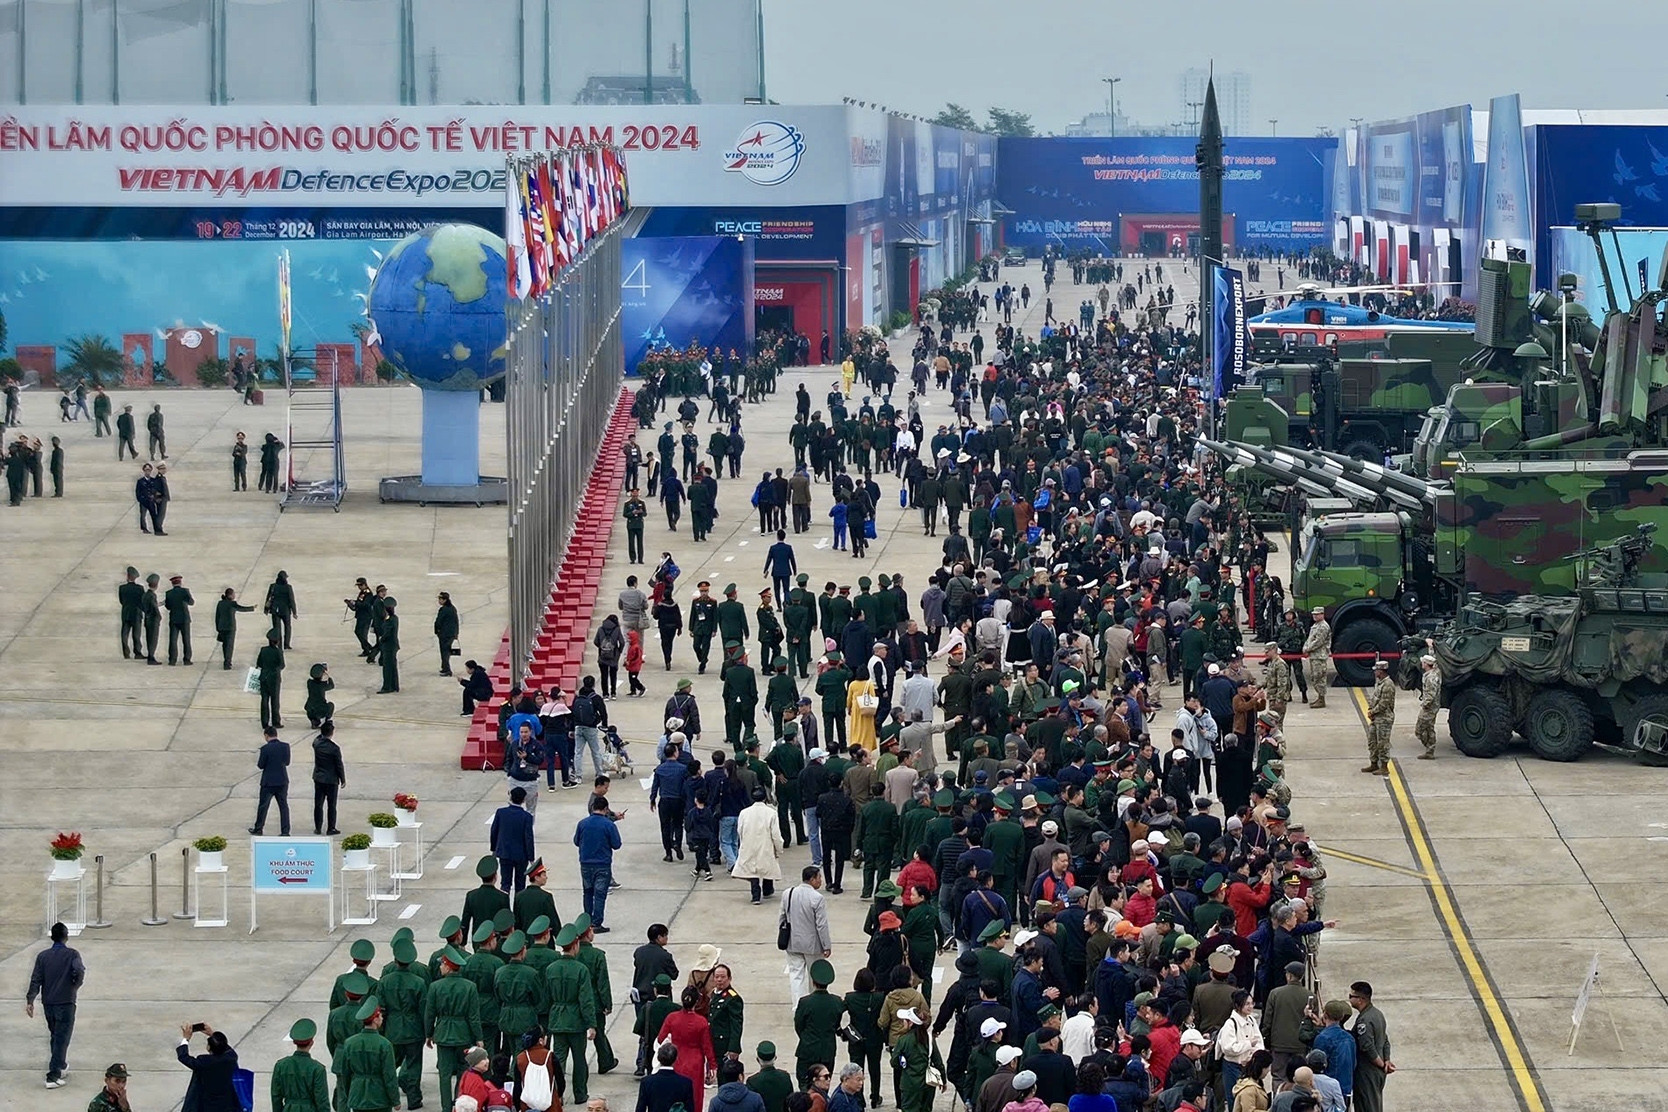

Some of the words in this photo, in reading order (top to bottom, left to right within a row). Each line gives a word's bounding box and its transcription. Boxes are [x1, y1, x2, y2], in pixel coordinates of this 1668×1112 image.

[49, 120, 111, 150] LÃM
[120, 117, 208, 153] QUỐC
[216, 120, 324, 152] PHÒNG
[332, 117, 420, 153] QUỐC
[426, 117, 466, 151] TẾ
[545, 126, 614, 150] NAM
[622, 125, 701, 151] 2024
[197, 221, 215, 238] 19
[222, 221, 242, 238] 22
[279, 221, 316, 238] 2024
[715, 221, 762, 233] PEACE
[1246, 221, 1292, 233] PEACE
[1232, 276, 1245, 376] ROSOBORNEXPORT
